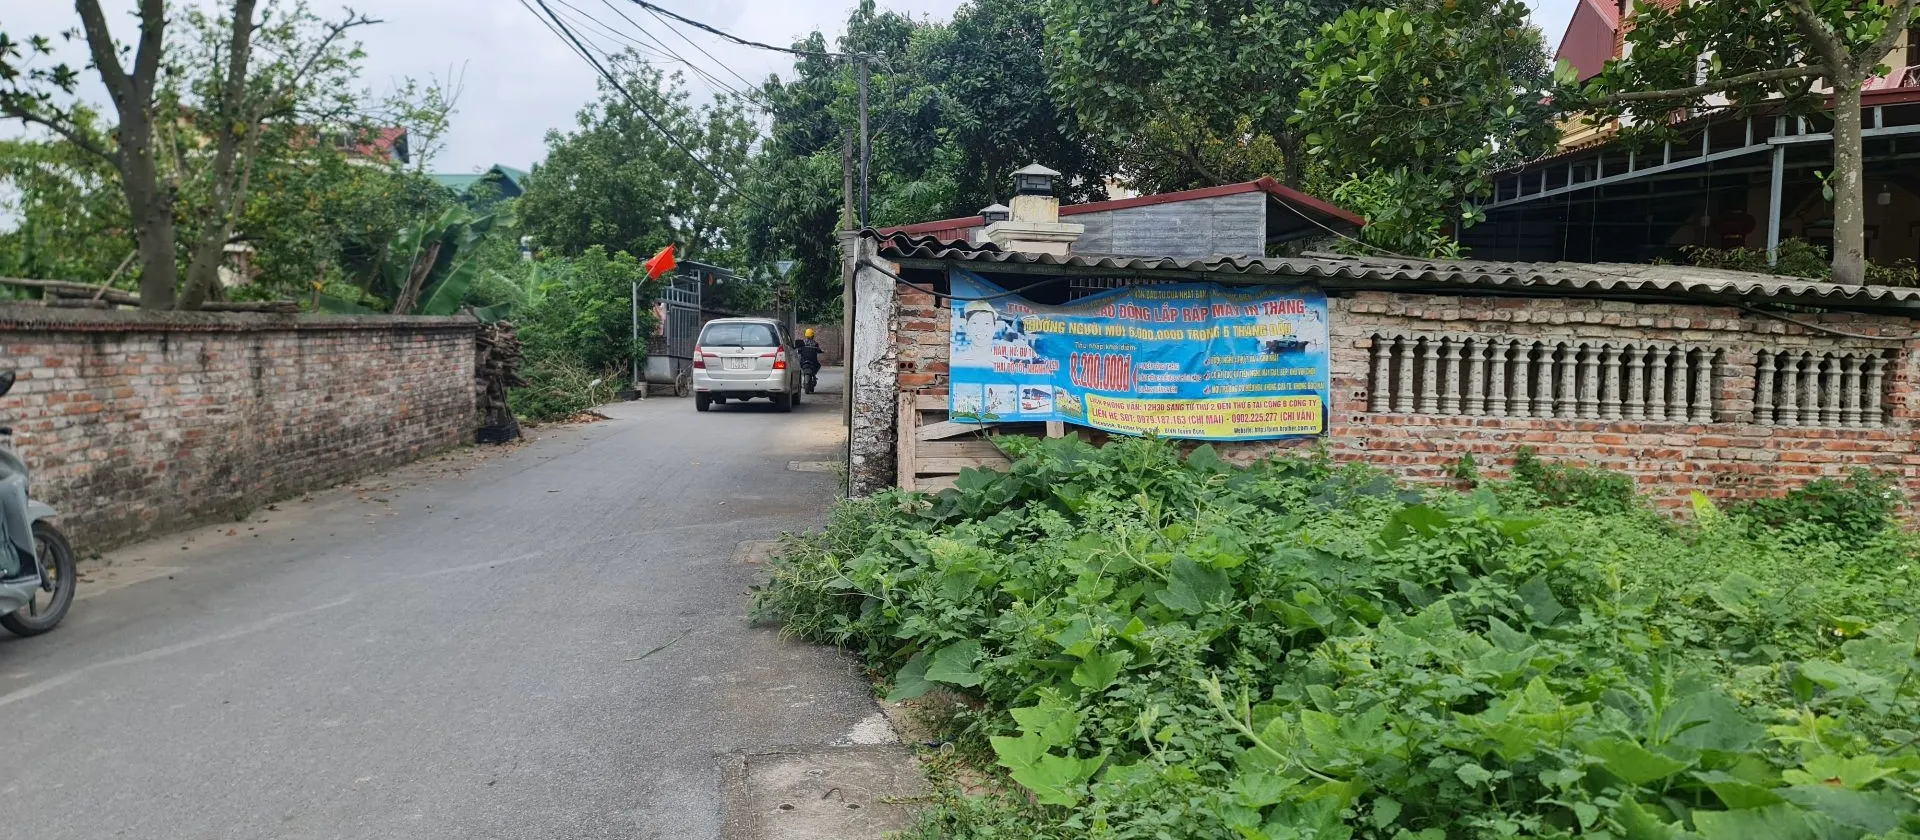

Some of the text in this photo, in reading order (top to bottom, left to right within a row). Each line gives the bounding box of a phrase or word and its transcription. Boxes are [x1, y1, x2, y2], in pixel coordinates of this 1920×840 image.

[1119, 302, 1151, 320] ĐỘNG
[1182, 304, 1208, 322] RÁP
[1069, 321, 1101, 335] NGƯỜI
[1106, 323, 1125, 337] MỚI
[1188, 326, 1219, 341] TRONG
[1233, 323, 1267, 338] THÁNG
[1074, 341, 1086, 349] Thu
[1144, 403, 1165, 411] 12H30
[1309, 399, 1317, 407] TY
[1232, 411, 1278, 423] 0902.225.277
[1234, 426, 1253, 434] Website:
